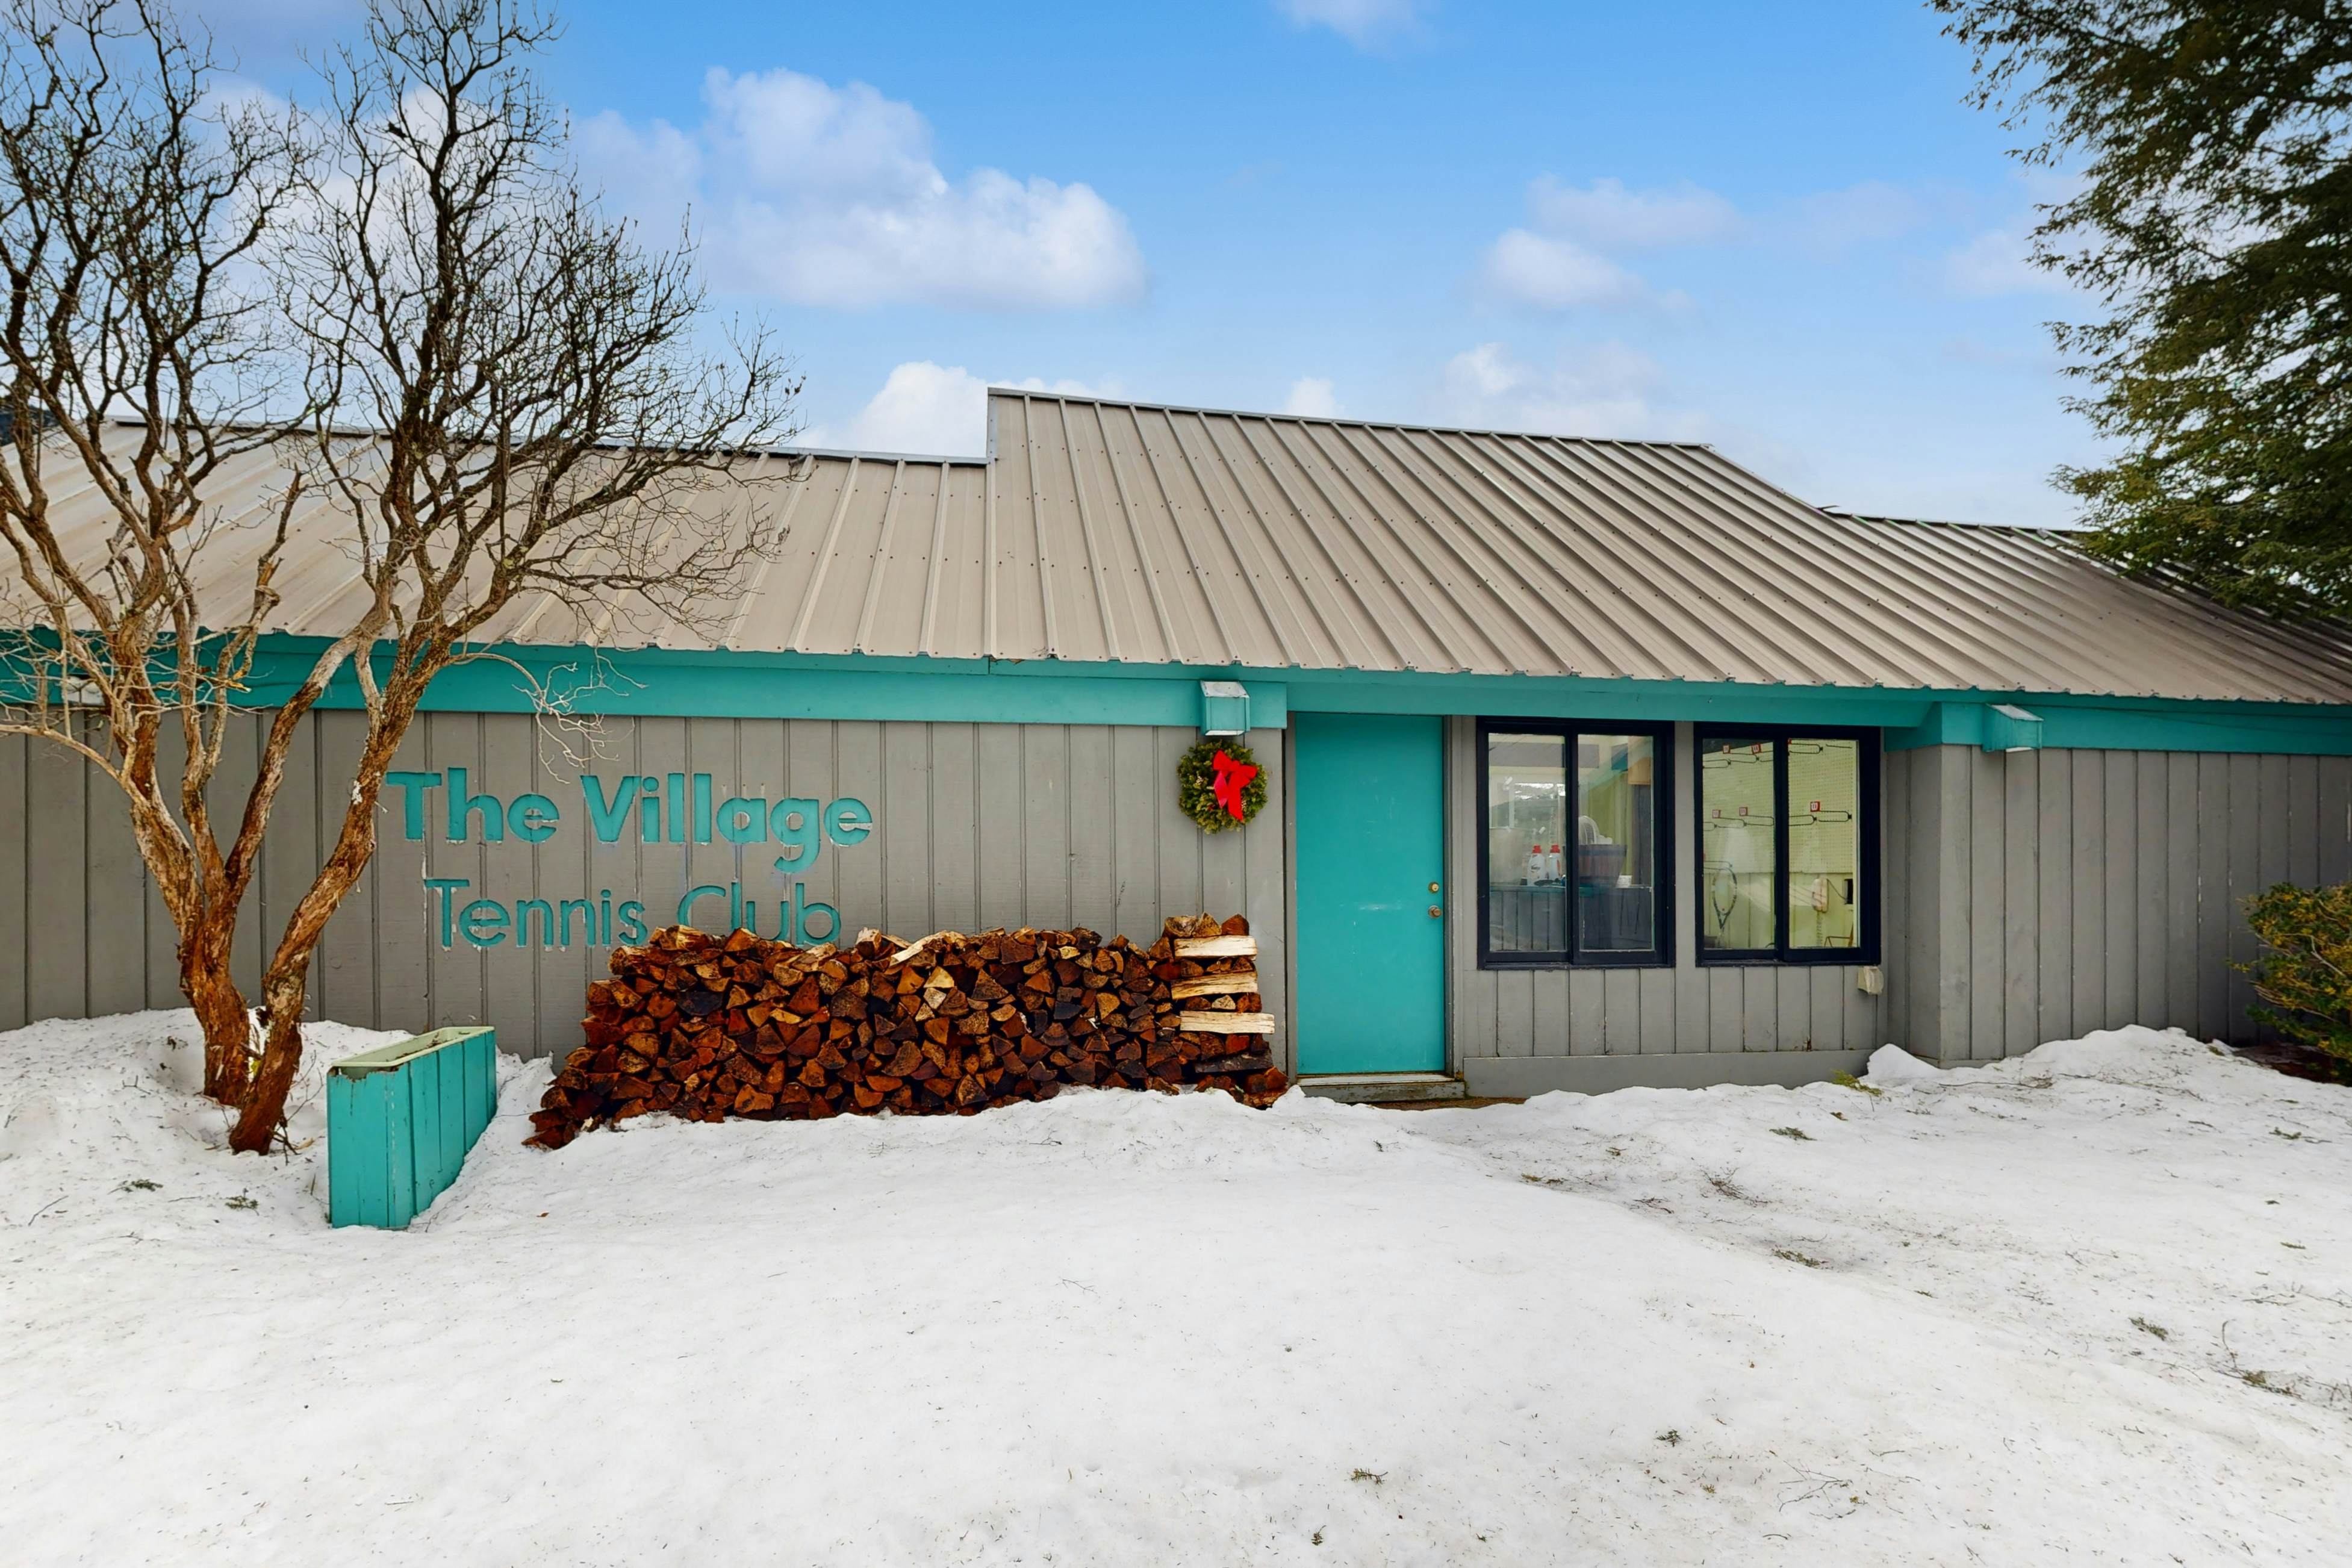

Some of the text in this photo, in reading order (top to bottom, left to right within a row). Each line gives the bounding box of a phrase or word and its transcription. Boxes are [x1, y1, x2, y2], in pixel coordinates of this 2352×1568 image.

[386, 767, 873, 874] The Village
[423, 879, 841, 948] Tennis Club
